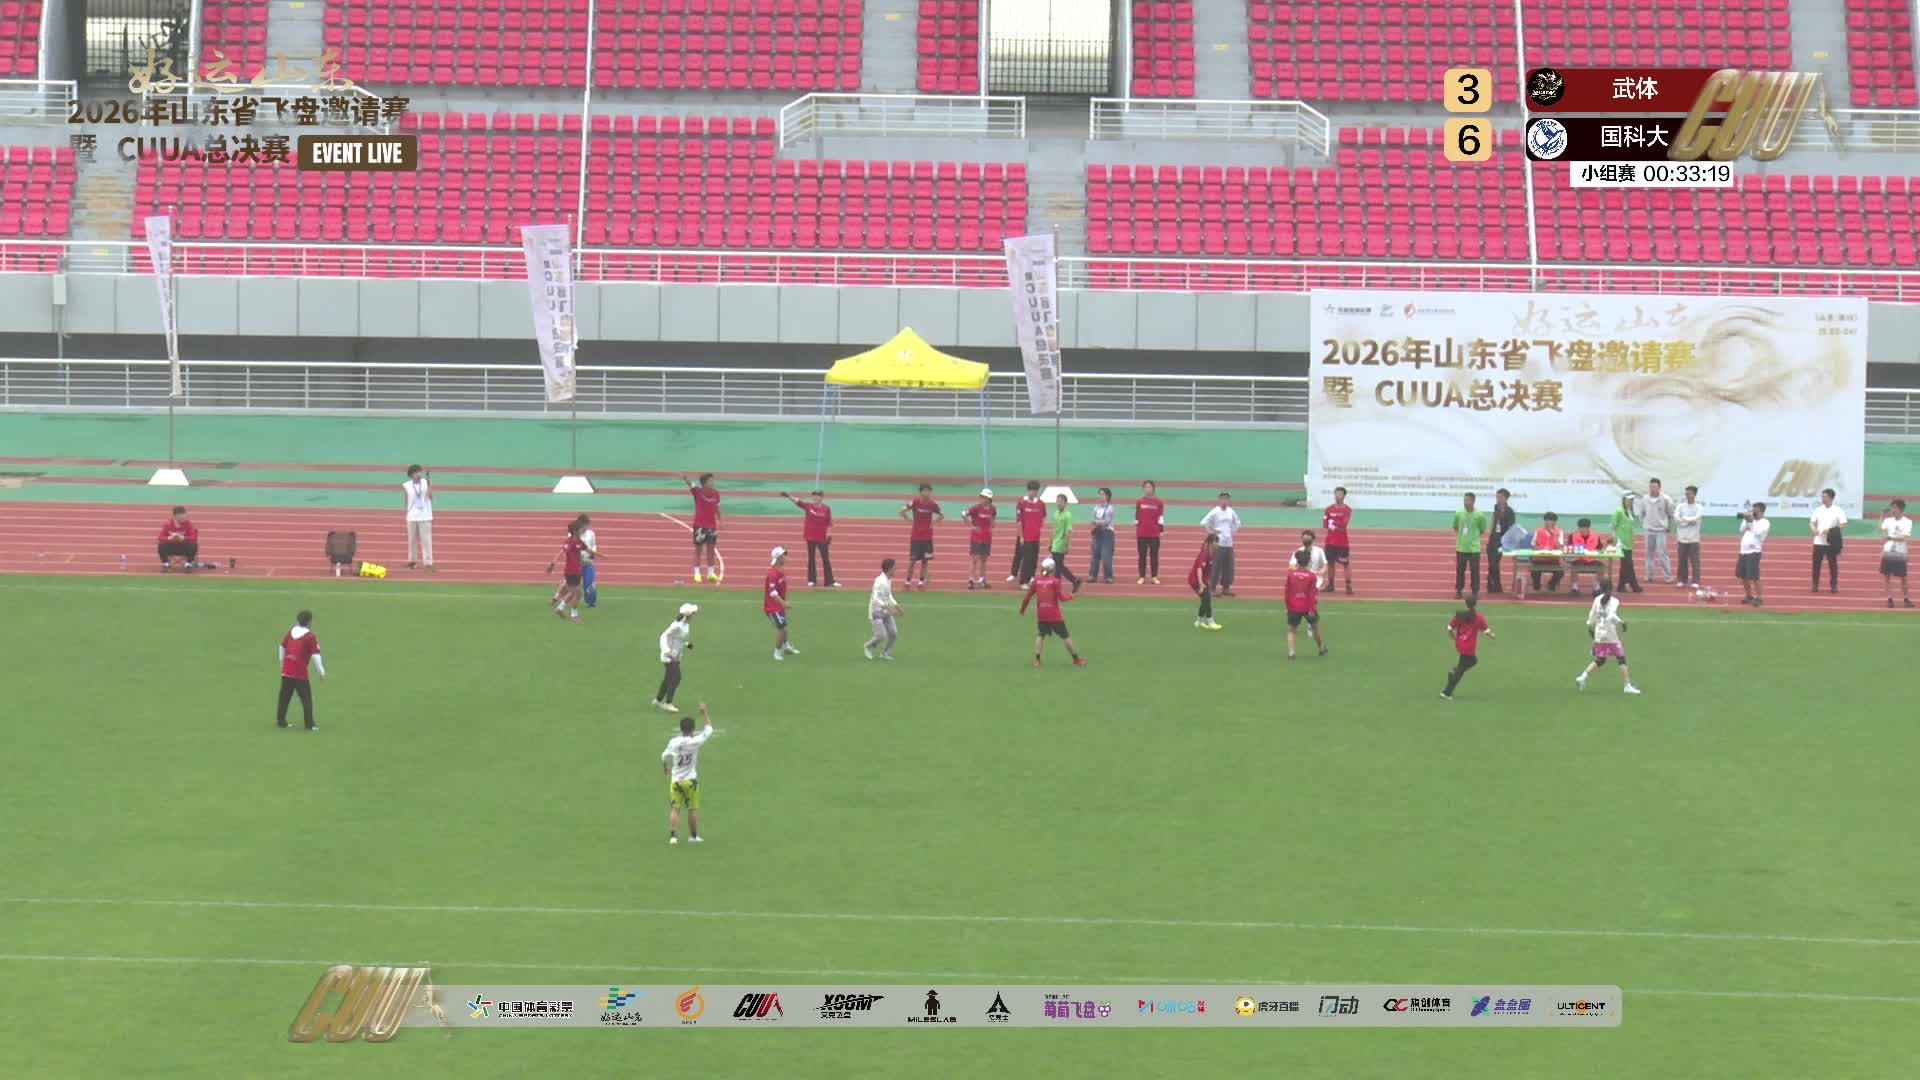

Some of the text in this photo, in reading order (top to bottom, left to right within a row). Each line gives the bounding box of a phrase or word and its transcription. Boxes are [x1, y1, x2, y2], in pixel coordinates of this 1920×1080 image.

[1322, 338, 1696, 372] 2026年山东省飞盘邀请赛
[1322, 376, 1564, 412] 暨 CUUA总决赛
